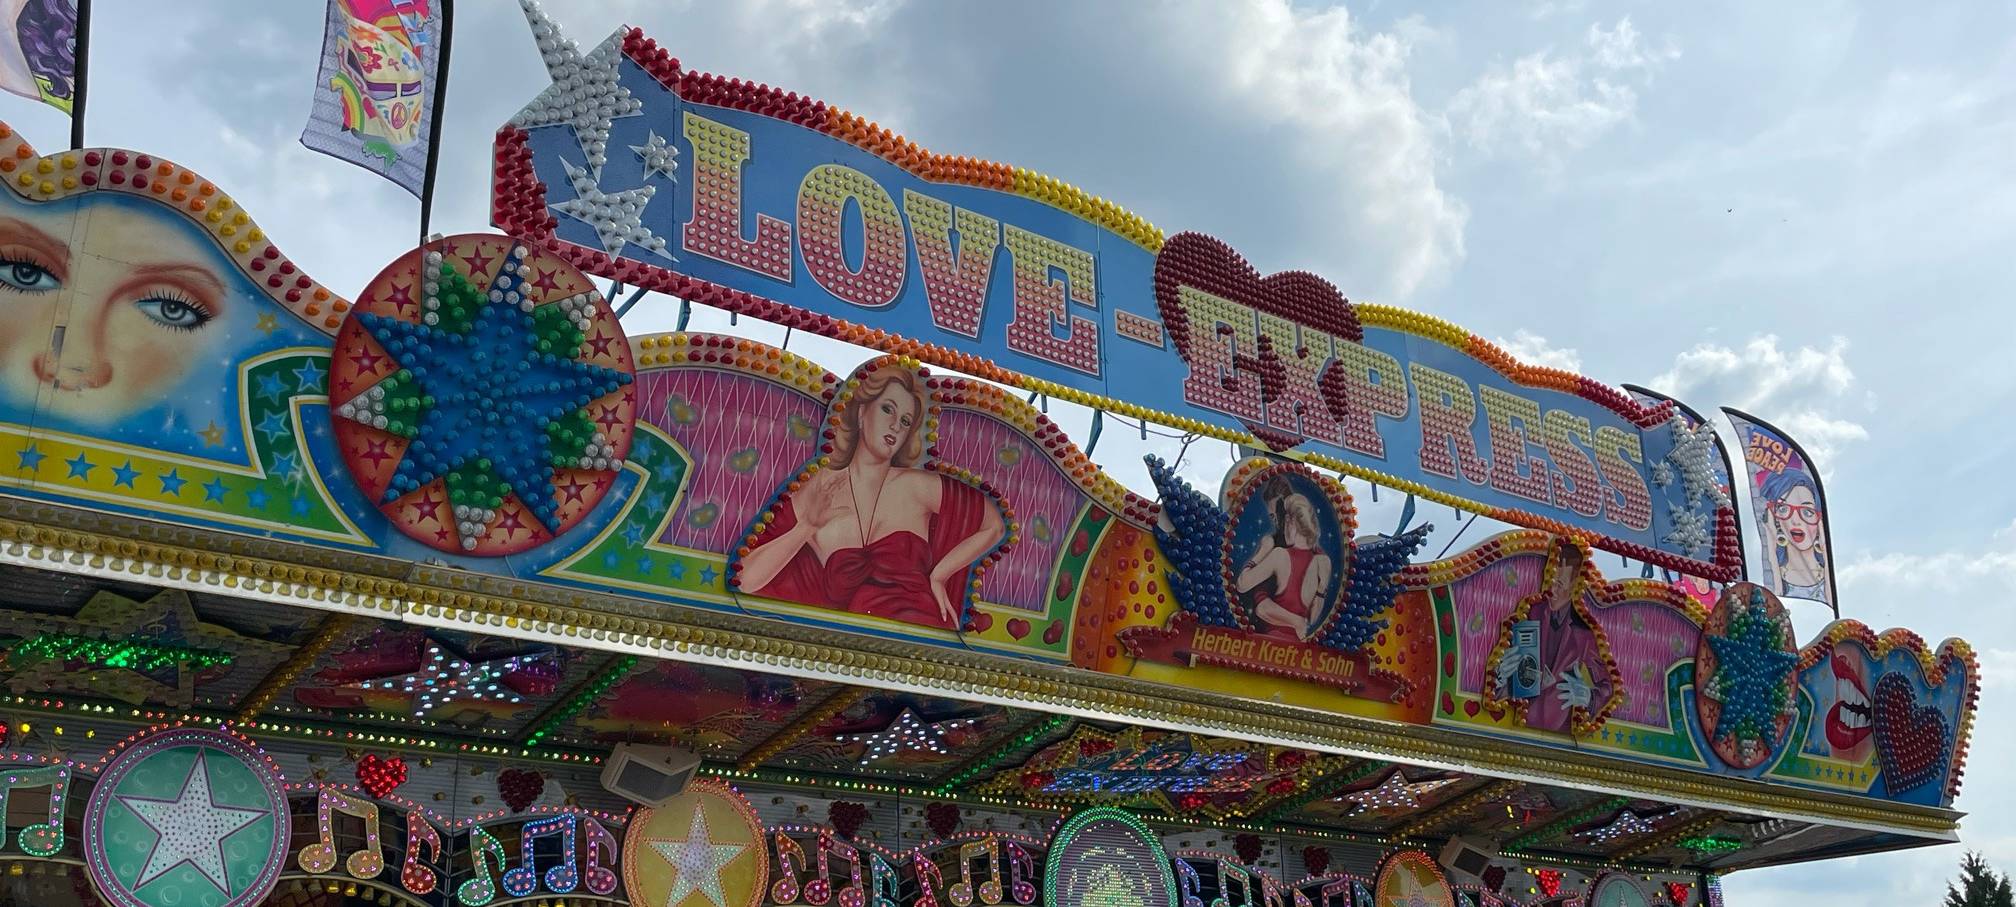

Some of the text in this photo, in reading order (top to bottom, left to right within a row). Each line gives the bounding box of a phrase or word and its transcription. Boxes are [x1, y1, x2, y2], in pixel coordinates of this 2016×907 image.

[1191, 627, 1355, 677] Herbert Kreft & Sohn
